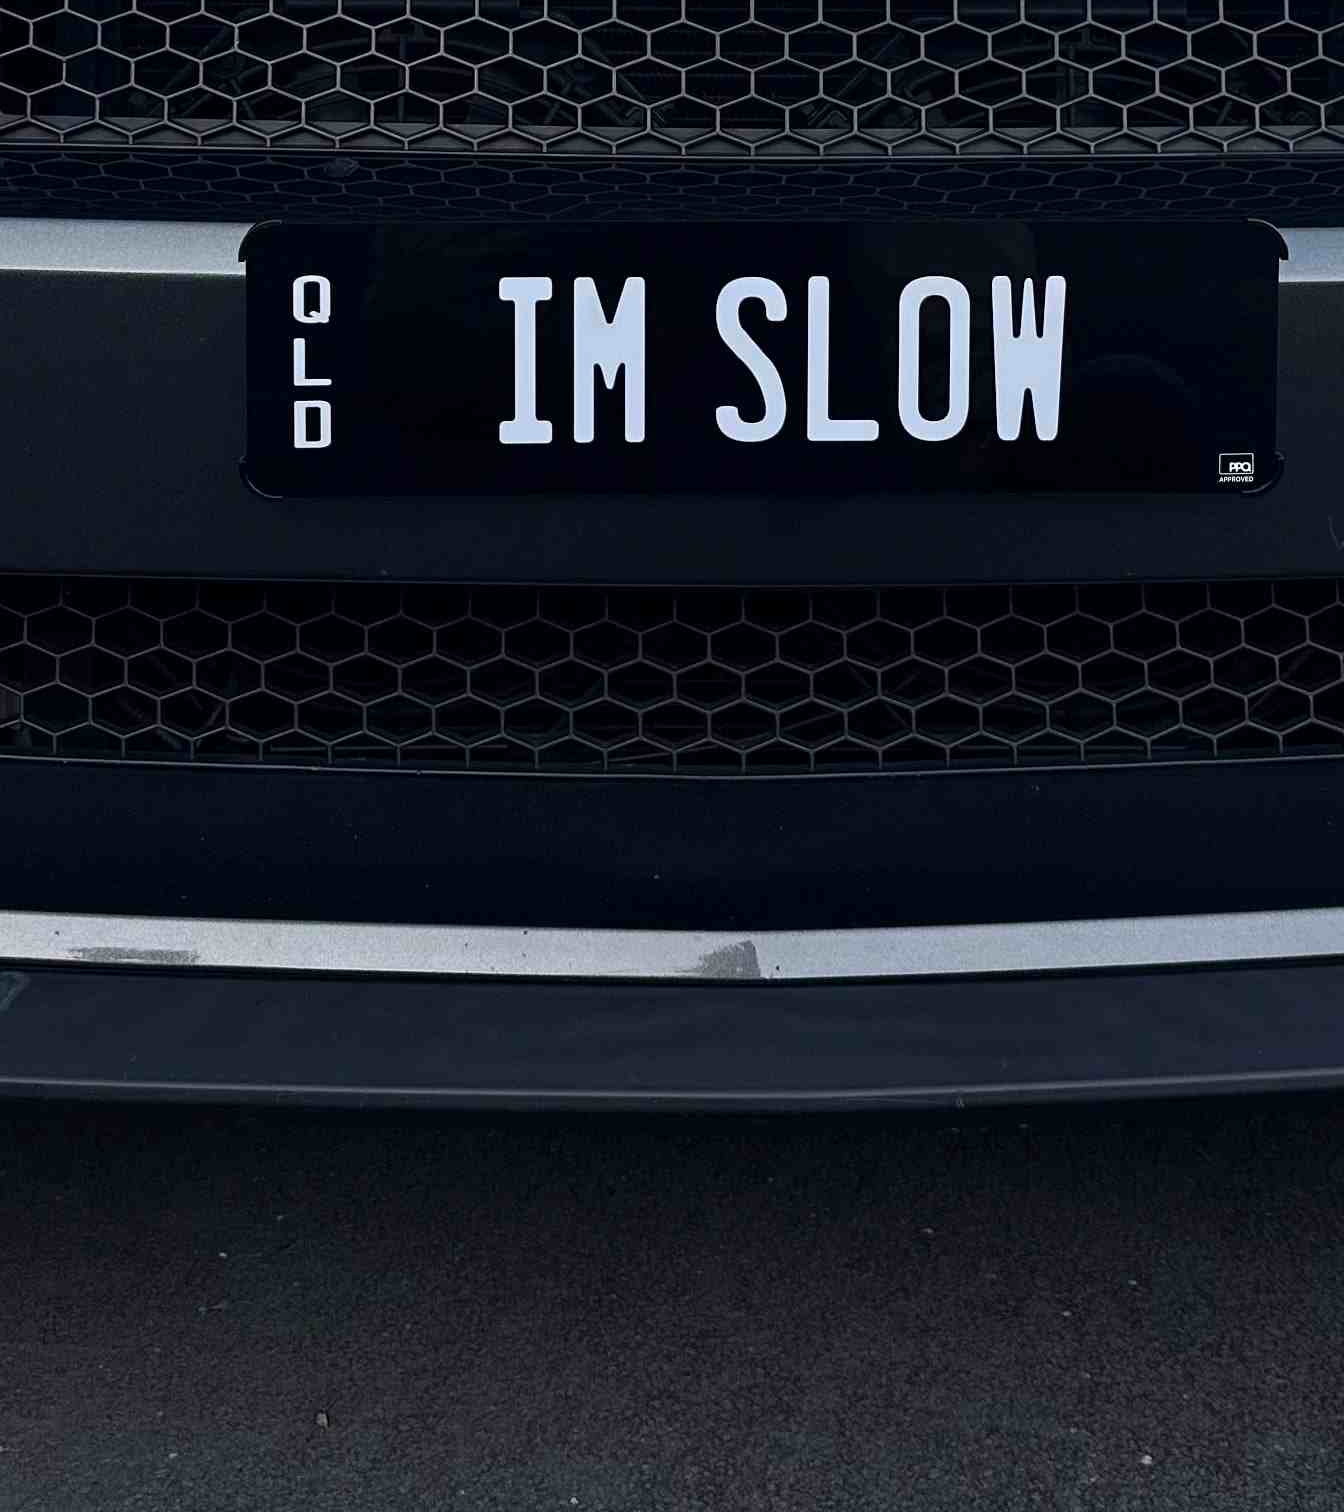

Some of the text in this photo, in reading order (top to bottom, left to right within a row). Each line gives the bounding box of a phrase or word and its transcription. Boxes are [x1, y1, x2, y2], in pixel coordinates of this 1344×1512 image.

[292, 274, 332, 449] QLD
[498, 275, 1067, 445] IM SLOW
[1229, 461, 1252, 473] PPQ
